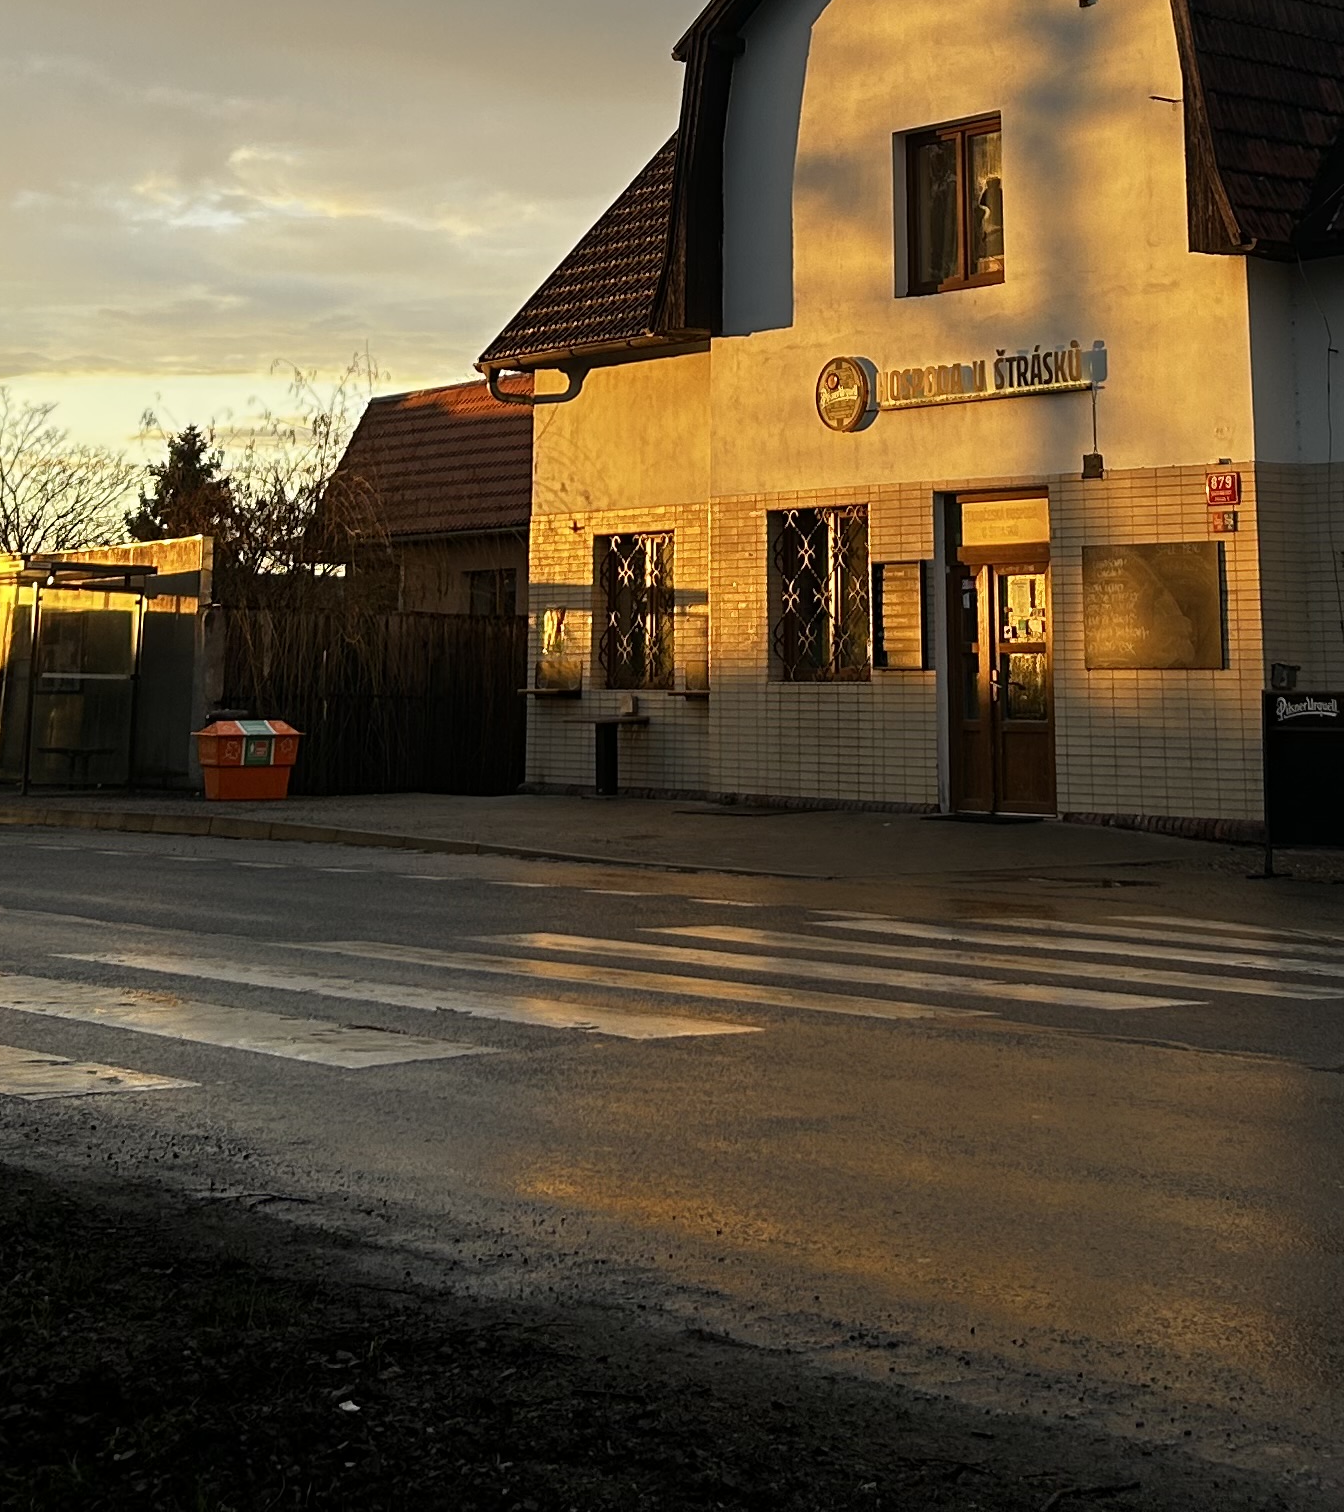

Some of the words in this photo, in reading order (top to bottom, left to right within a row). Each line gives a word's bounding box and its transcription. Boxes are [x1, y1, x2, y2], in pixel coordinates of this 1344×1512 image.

[972, 359, 986, 393] U
[994, 340, 1082, 390] ŠTRÁSKŮ
[1211, 475, 1232, 489] 879
[1276, 696, 1307, 721] Pilsner
[1306, 696, 1340, 717] Urquell
